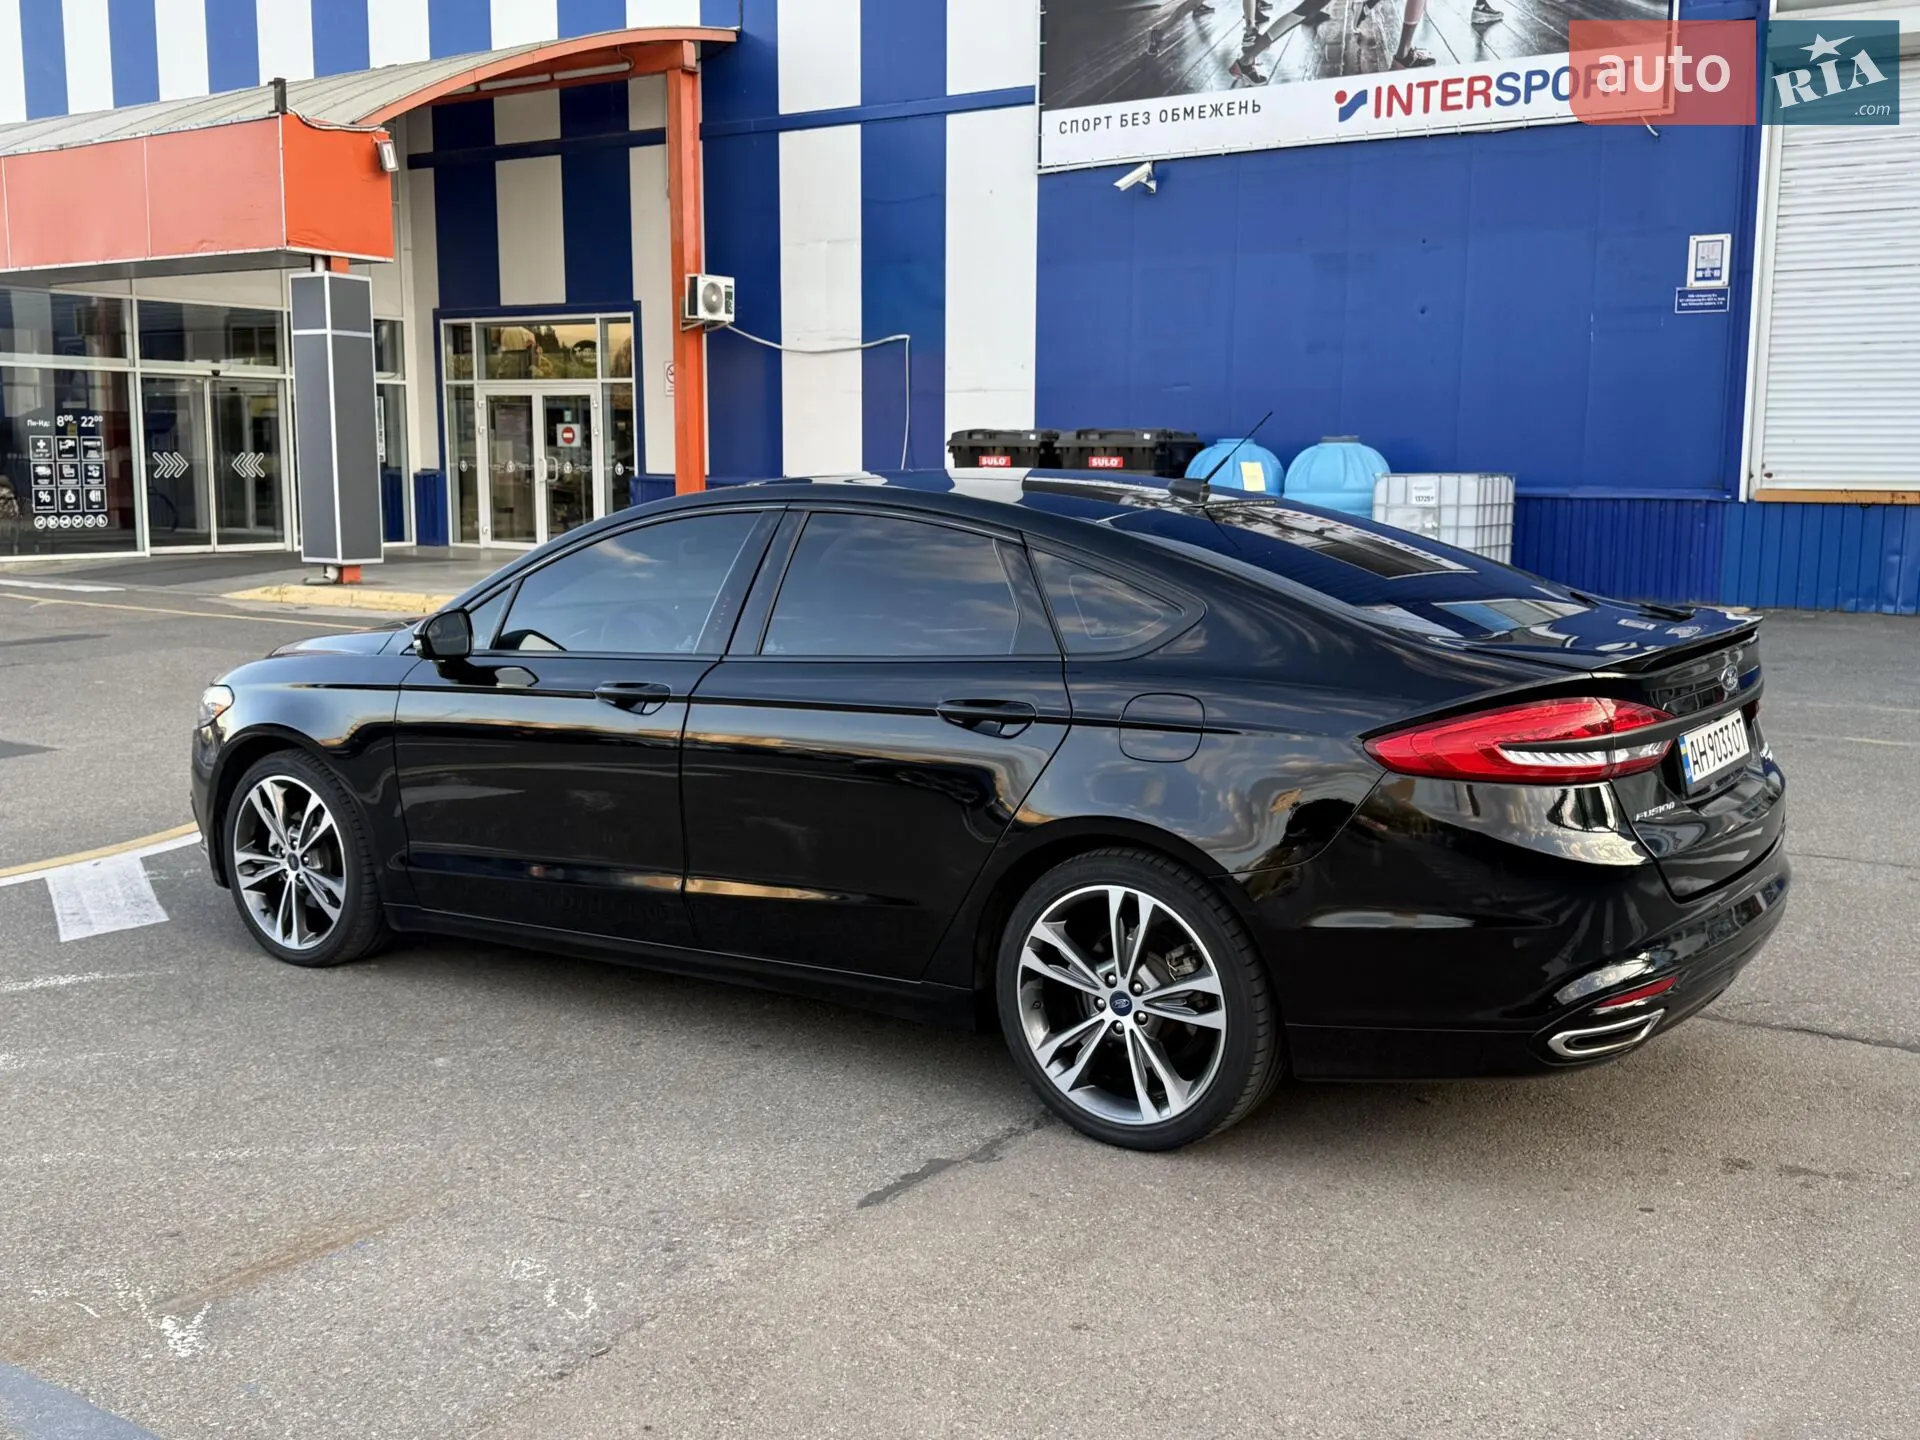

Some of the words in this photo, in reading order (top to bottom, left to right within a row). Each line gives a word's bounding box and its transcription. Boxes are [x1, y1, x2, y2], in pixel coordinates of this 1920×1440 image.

[1374, 59, 1641, 119] INTERSPORT
[1058, 115, 1113, 135] СПОРТ
[1119, 111, 1151, 128] БЕЗ
[1159, 99, 1262, 123] ОБМЕЖЕНЬ
[981, 456, 1007, 466] SULO
[1091, 457, 1119, 467] SULO
